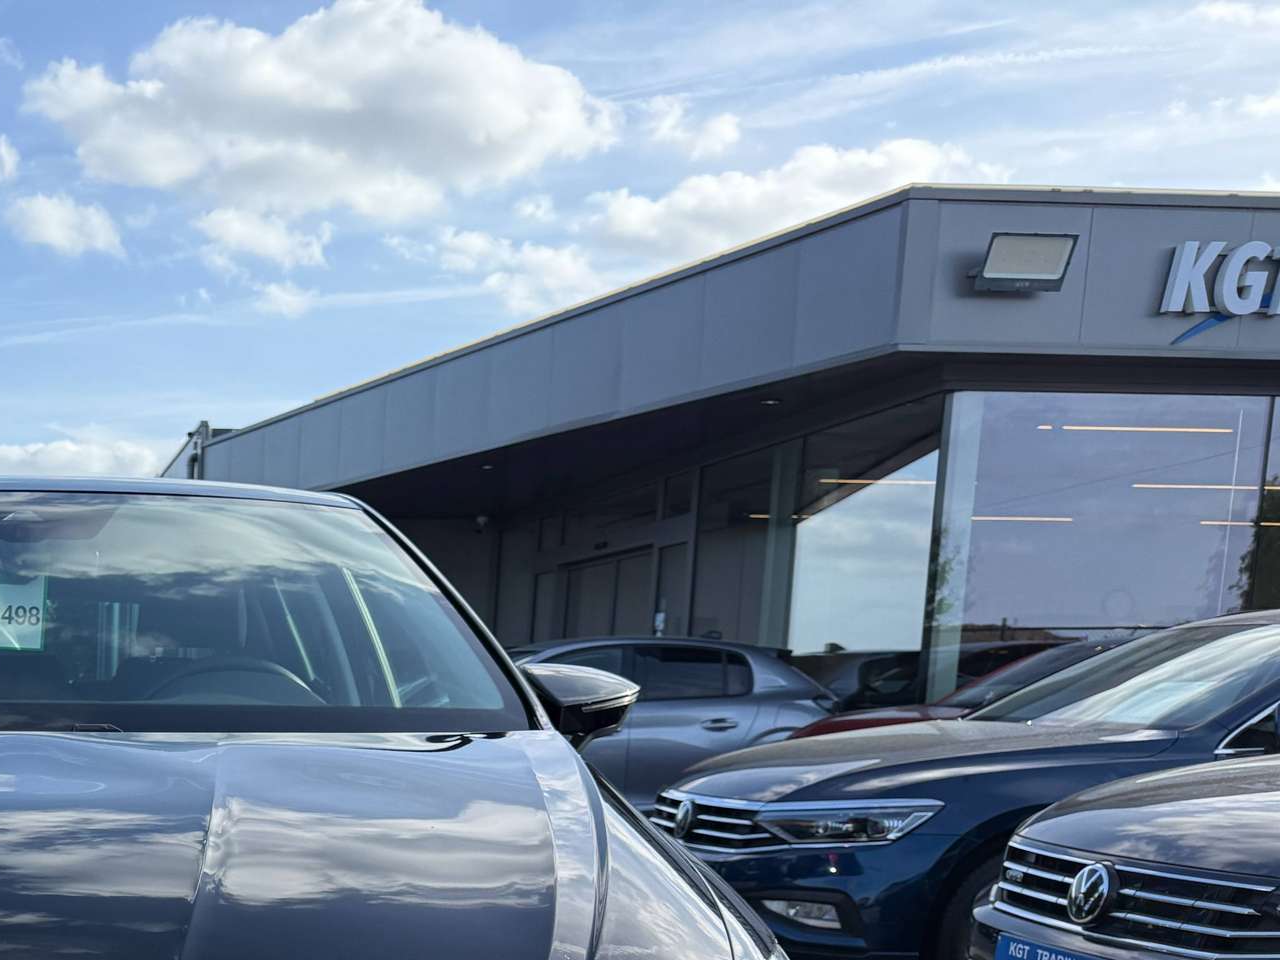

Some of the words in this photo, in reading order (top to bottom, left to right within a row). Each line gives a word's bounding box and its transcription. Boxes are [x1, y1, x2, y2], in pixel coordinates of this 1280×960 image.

[1160, 240, 1280, 315] KG
[1, 604, 41, 626] 498
[1008, 942, 1031, 960] KGT
